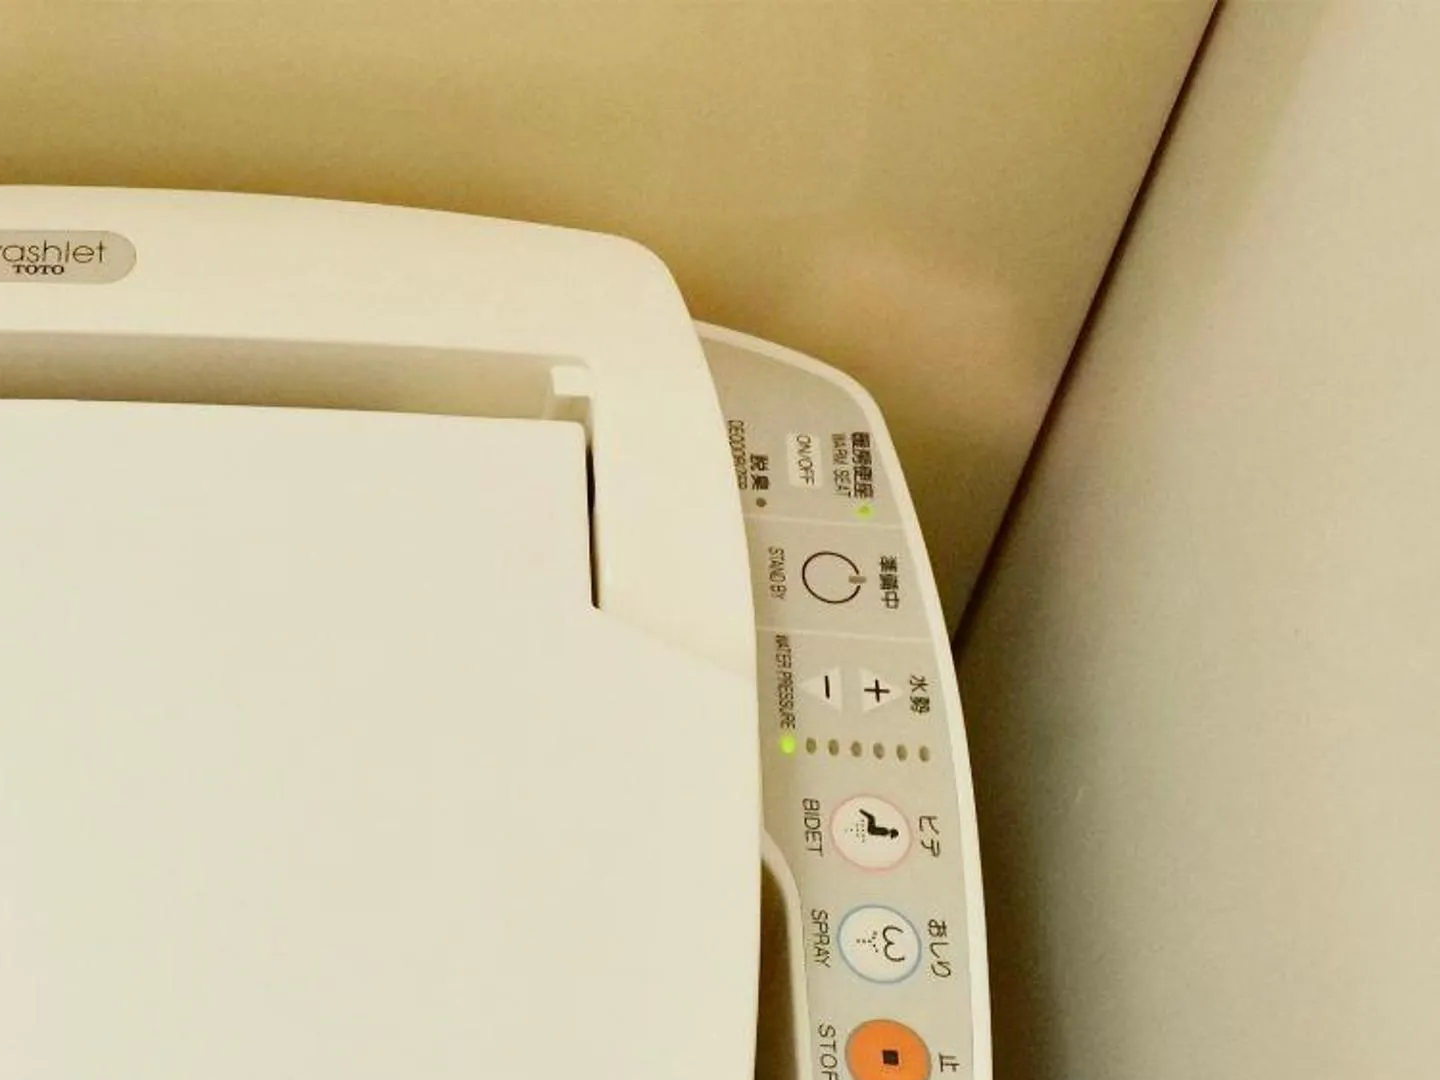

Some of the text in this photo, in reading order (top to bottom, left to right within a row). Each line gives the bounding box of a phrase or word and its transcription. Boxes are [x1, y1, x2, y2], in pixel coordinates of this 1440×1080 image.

[11, 264, 65, 276] TOTO
[796, 434, 815, 485] ON/OFF
[831, 433, 852, 498] WARM SEAT
[771, 585, 787, 600] BY
[775, 634, 796, 729] WATER PRESSURE
[910, 675, 931, 714] 水勢
[802, 798, 823, 856] BIDET
[919, 815, 941, 858] ビデ
[811, 908, 831, 969] SPRAY
[928, 919, 952, 979] おしり
[939, 1052, 960, 1073] 止
